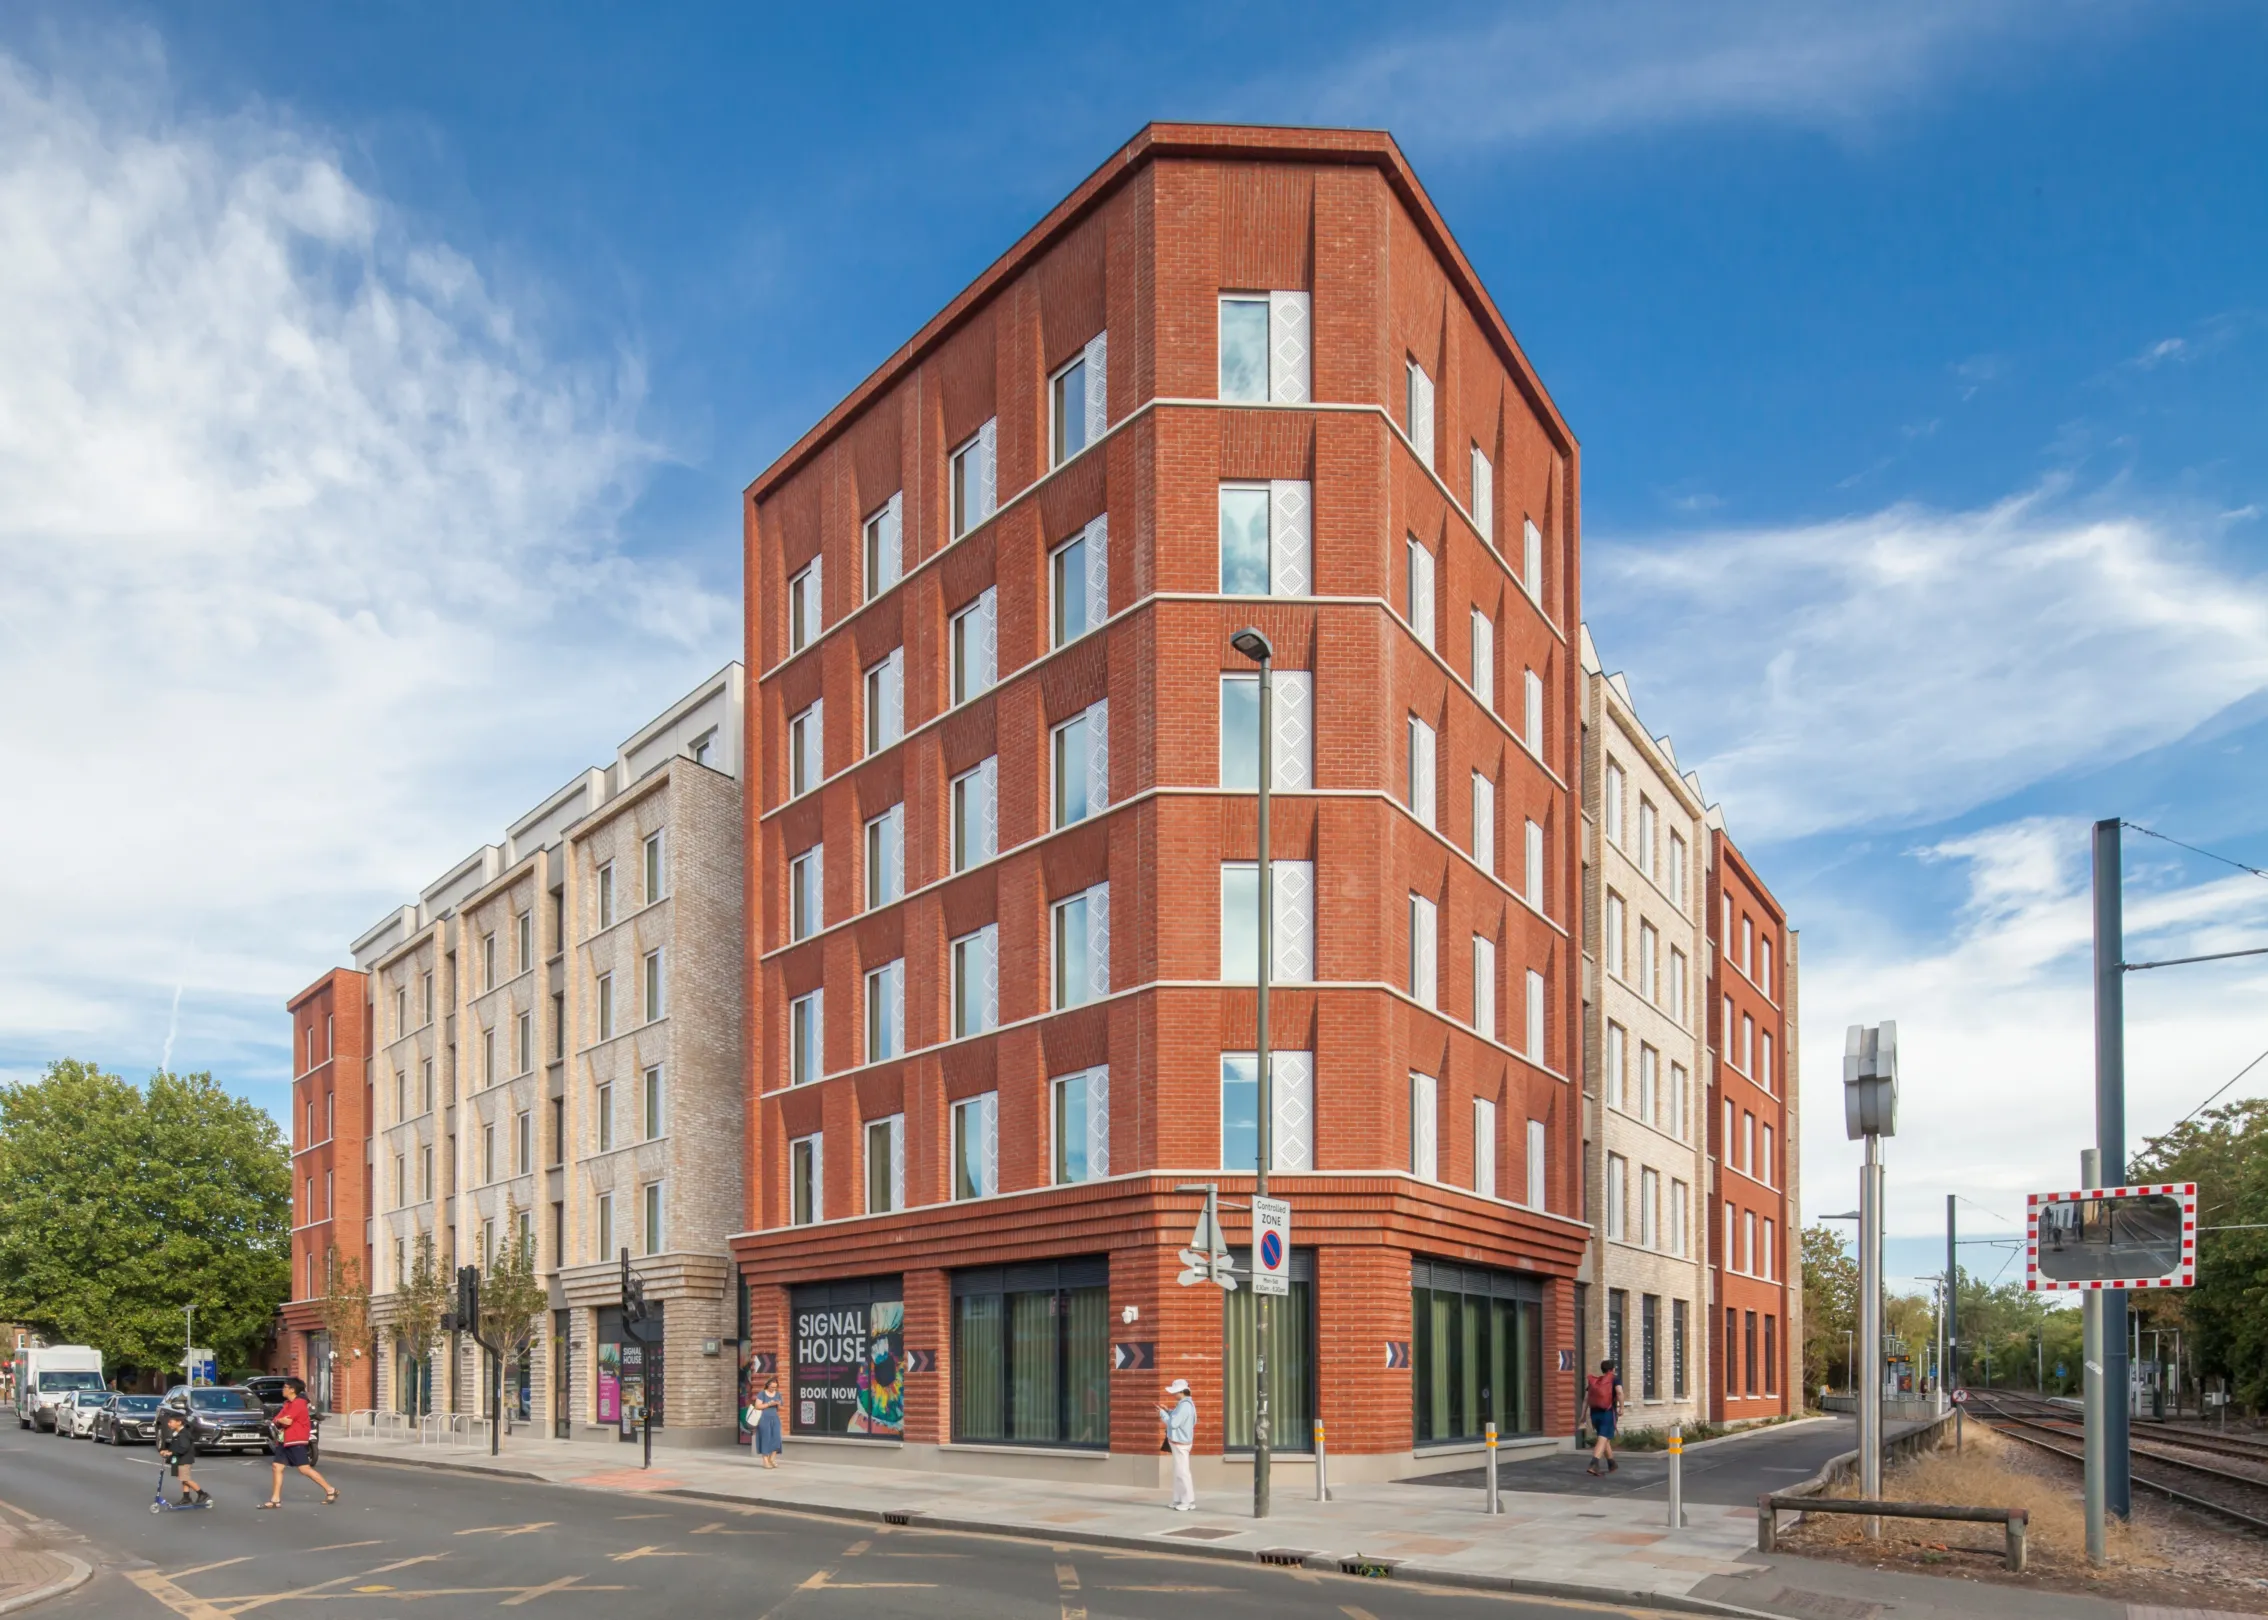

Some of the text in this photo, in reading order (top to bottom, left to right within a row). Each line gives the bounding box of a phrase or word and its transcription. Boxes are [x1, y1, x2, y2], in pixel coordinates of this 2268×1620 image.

[1257, 1200, 1286, 1213] Controlled
[1262, 1214, 1281, 1226] ZONE
[799, 1311, 866, 1337] SIGNAL
[623, 1347, 642, 1355] SIGNAL
[799, 1337, 866, 1363] HOUSE
[623, 1355, 642, 1364] HOUSE
[800, 1387, 857, 1399] BOOK NOW
